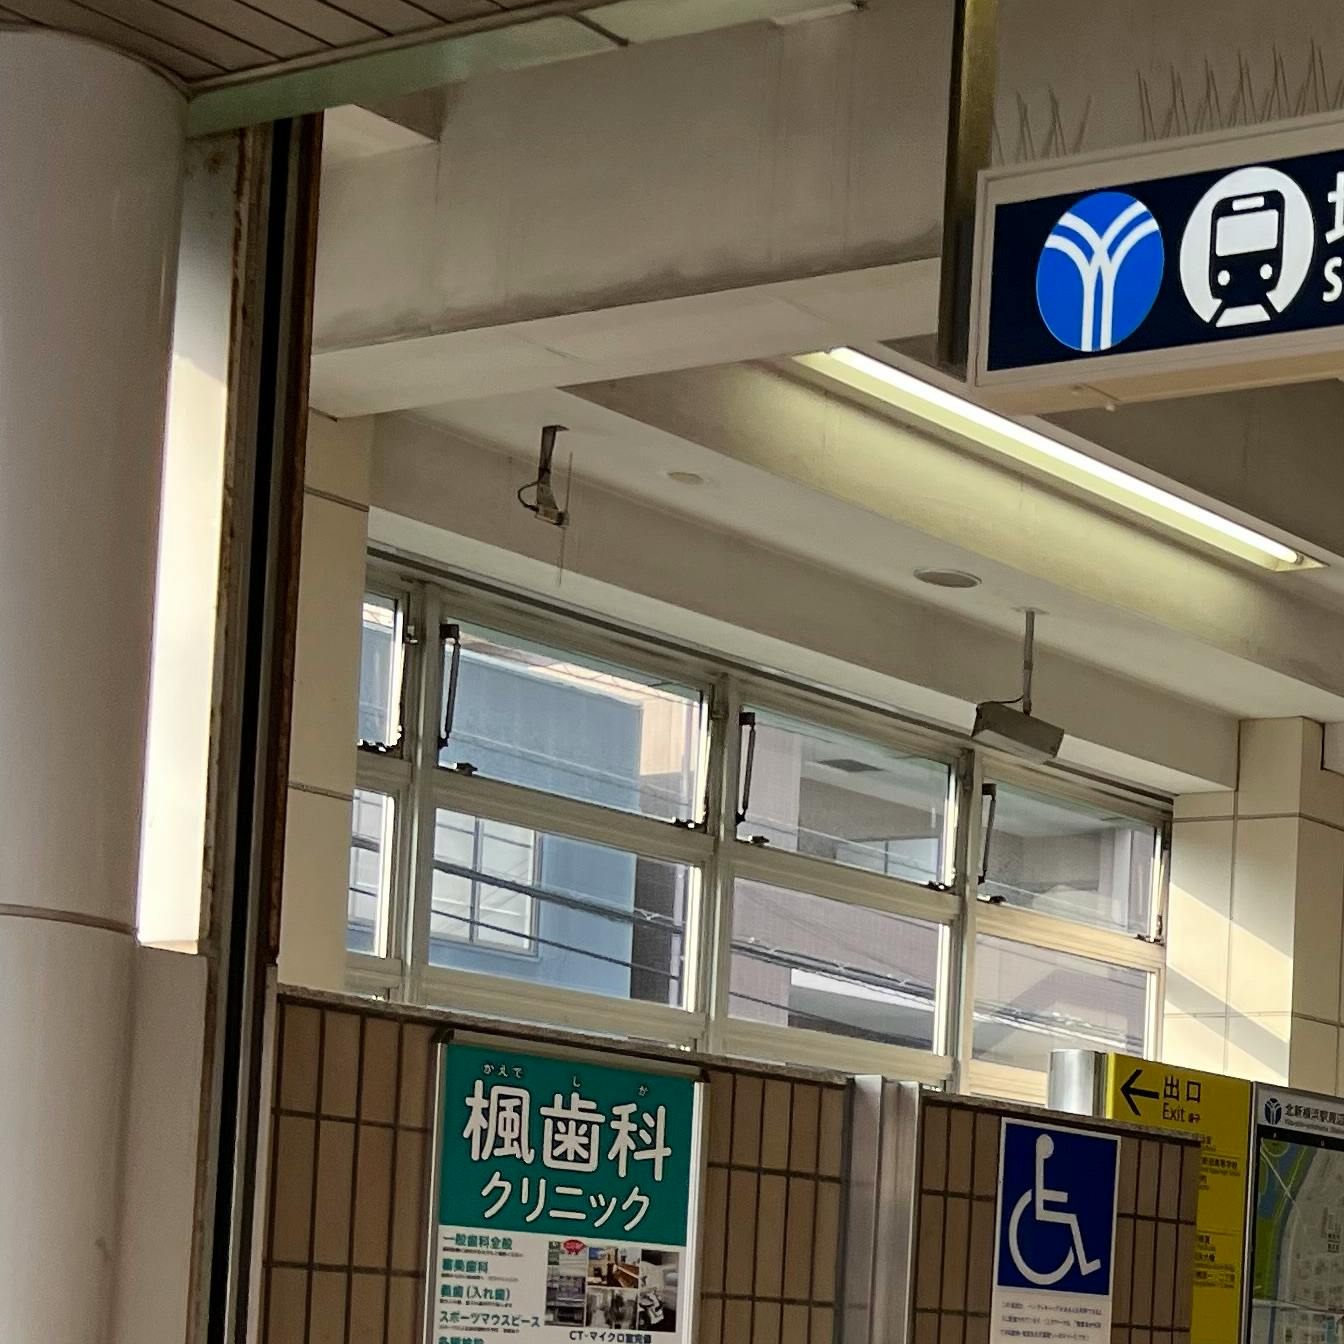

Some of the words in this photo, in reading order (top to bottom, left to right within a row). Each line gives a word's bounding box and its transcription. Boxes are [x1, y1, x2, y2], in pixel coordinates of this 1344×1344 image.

[1163, 1075, 1201, 1103] 出口
[463, 1080, 672, 1182] 楓歯科
[1163, 1102, 1185, 1122] Exit
[481, 1171, 650, 1232] クリニック
